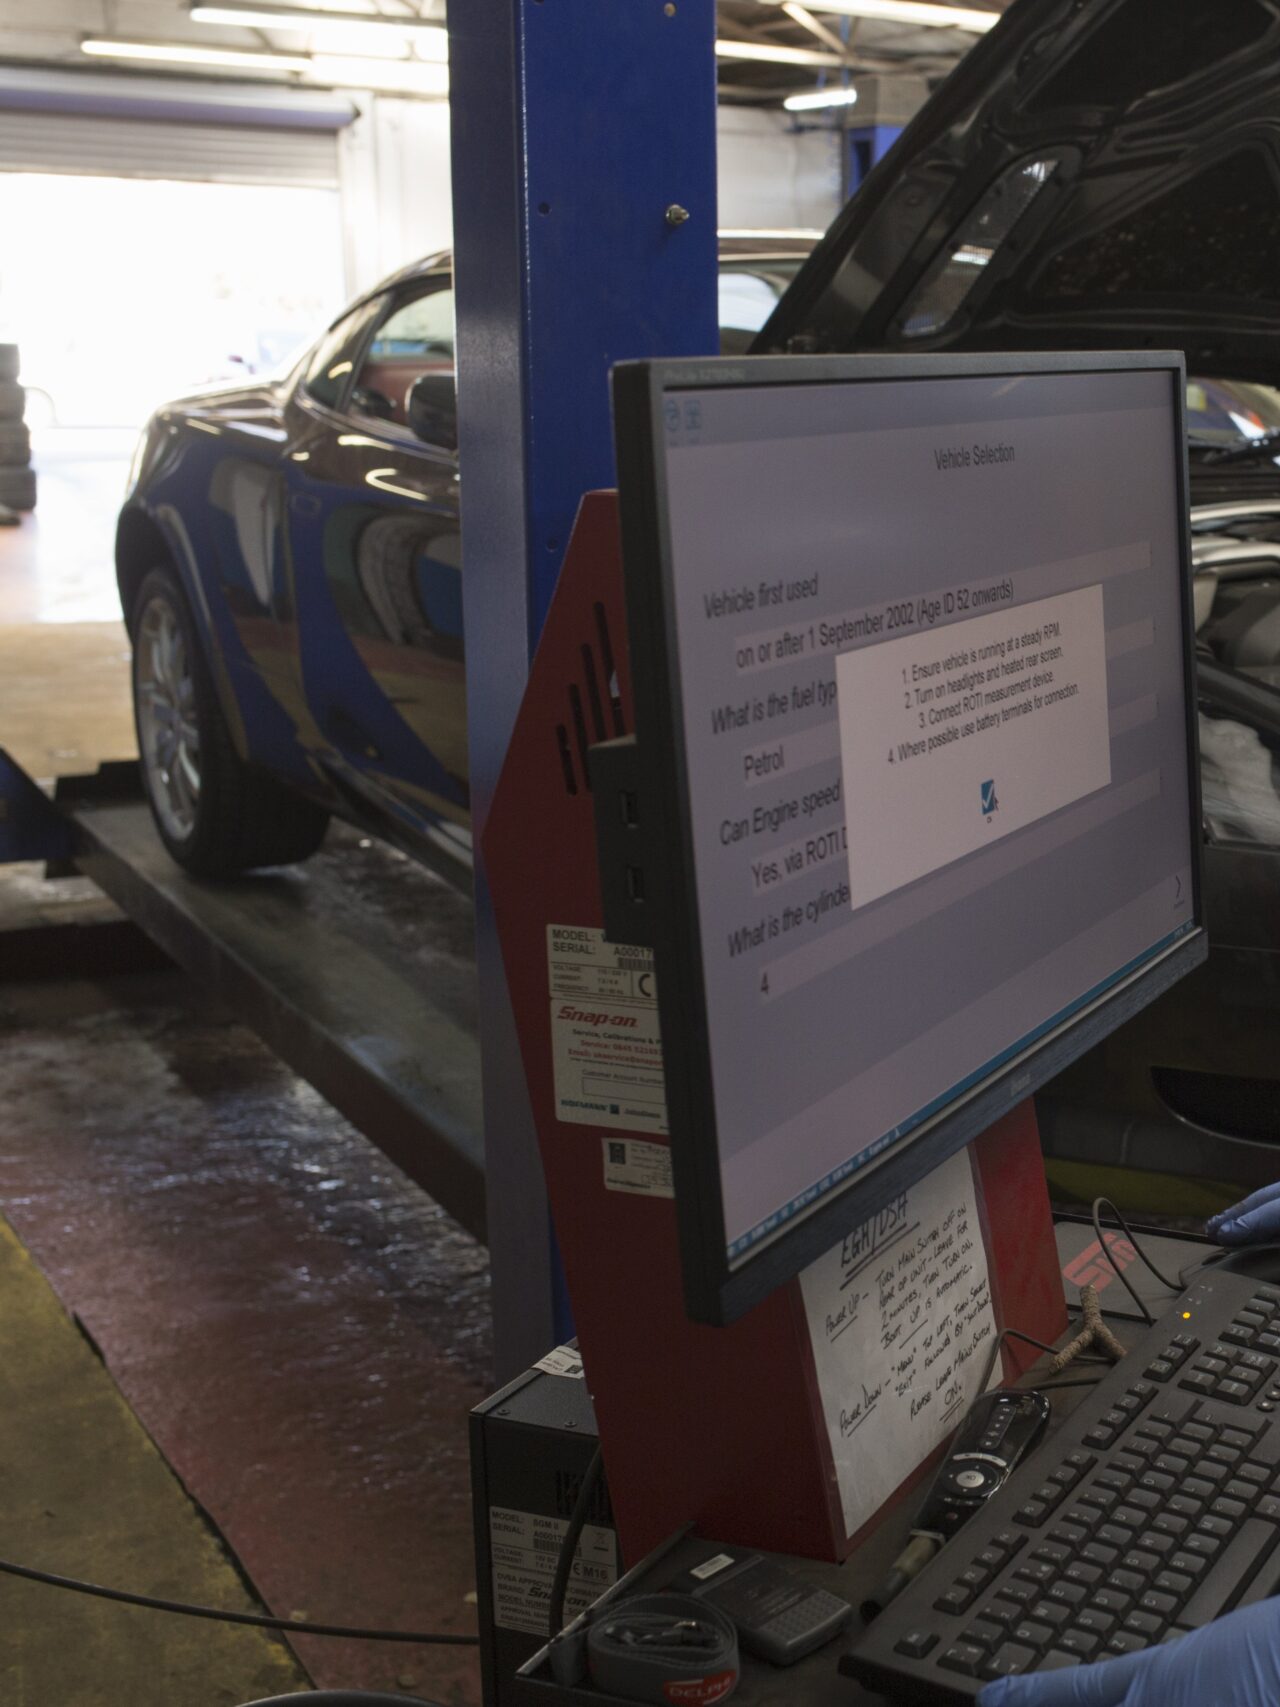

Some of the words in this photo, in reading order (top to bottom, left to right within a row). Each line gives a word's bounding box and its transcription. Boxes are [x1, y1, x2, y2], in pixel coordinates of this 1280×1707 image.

[933, 445, 971, 471] Vehicle
[973, 442, 1015, 466] Selection
[703, 586, 756, 619] Vehicle
[758, 579, 783, 608] first
[786, 571, 819, 601] used
[736, 646, 755, 669] on
[758, 641, 772, 664] or
[774, 631, 805, 659] after
[808, 625, 815, 649] 1
[819, 611, 884, 648] September
[886, 602, 914, 631] 2002
[917, 597, 942, 629] (Age
[943, 591, 955, 616] ID
[957, 588, 970, 611] 52
[972, 577, 1014, 608] onwards)
[904, 691, 914, 710] 2.
[914, 687, 935, 707] Turn
[935, 684, 947, 699] on
[946, 668, 985, 693] headlights
[986, 663, 1000, 682] and
[1000, 655, 1024, 678] heated
[1025, 653, 1039, 670] rear
[1040, 645, 1064, 665] screen.
[911, 661, 941, 682] Ensure
[941, 649, 969, 672] vehicle
[970, 647, 977, 663] is
[978, 640, 1006, 661] running
[1007, 636, 1014, 653] at
[1015, 637, 1020, 650] a
[1021, 627, 1042, 648] steady
[1043, 620, 1063, 641] RPM.
[711, 700, 750, 735] What
[752, 697, 765, 723] is
[767, 691, 789, 719] the
[791, 680, 816, 711] fuel
[897, 739, 926, 762] Where
[928, 725, 960, 755] possible
[960, 721, 975, 738] use
[976, 712, 1001, 732] battery
[1001, 697, 1033, 722] terminals
[1033, 693, 1043, 711] for
[1044, 682, 1081, 706] connection.
[928, 702, 962, 725] Connect
[963, 691, 983, 713] ROTI
[984, 673, 1033, 705] measurement
[1033, 668, 1056, 689] device.
[744, 743, 785, 781] Petrol
[719, 818, 750, 846] Can
[752, 799, 800, 834] Engine
[801, 778, 841, 818] speed
[751, 862, 784, 889] Yes,
[784, 847, 805, 875] via
[805, 830, 839, 866] ROTI
[552, 928, 596, 942] MODEL:
[552, 941, 597, 956] SERIAL:
[727, 917, 766, 958] What
[768, 914, 780, 940] is
[782, 905, 804, 933] the
[760, 970, 771, 995] 4
[557, 1004, 640, 1028] Snap-on
